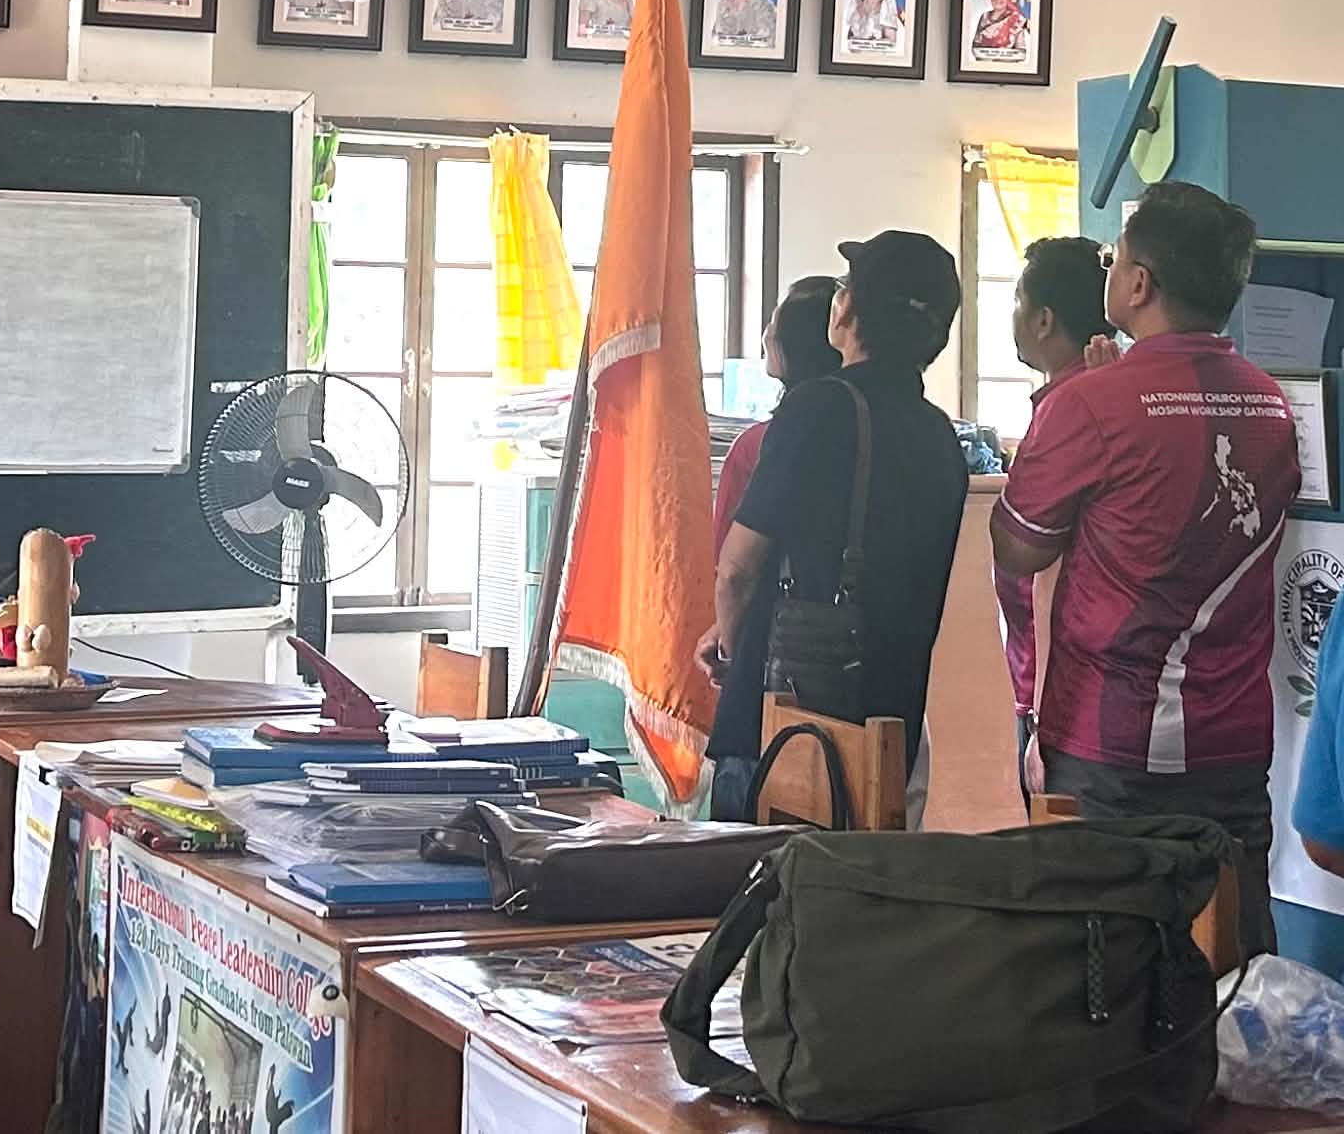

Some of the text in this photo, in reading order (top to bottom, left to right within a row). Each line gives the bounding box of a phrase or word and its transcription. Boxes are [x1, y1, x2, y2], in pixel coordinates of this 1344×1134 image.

[1140, 393, 1203, 404] NATIONWIDE
[1205, 393, 1242, 404] CHURCH
[1281, 553, 1344, 623] MUNICIPALITY OF
[121, 867, 188, 939] International
[190, 909, 217, 959] Peace
[219, 927, 283, 1007] Leadership
[129, 919, 149, 951] 120
[149, 928, 170, 965] Days
[250, 999, 274, 1037] from
